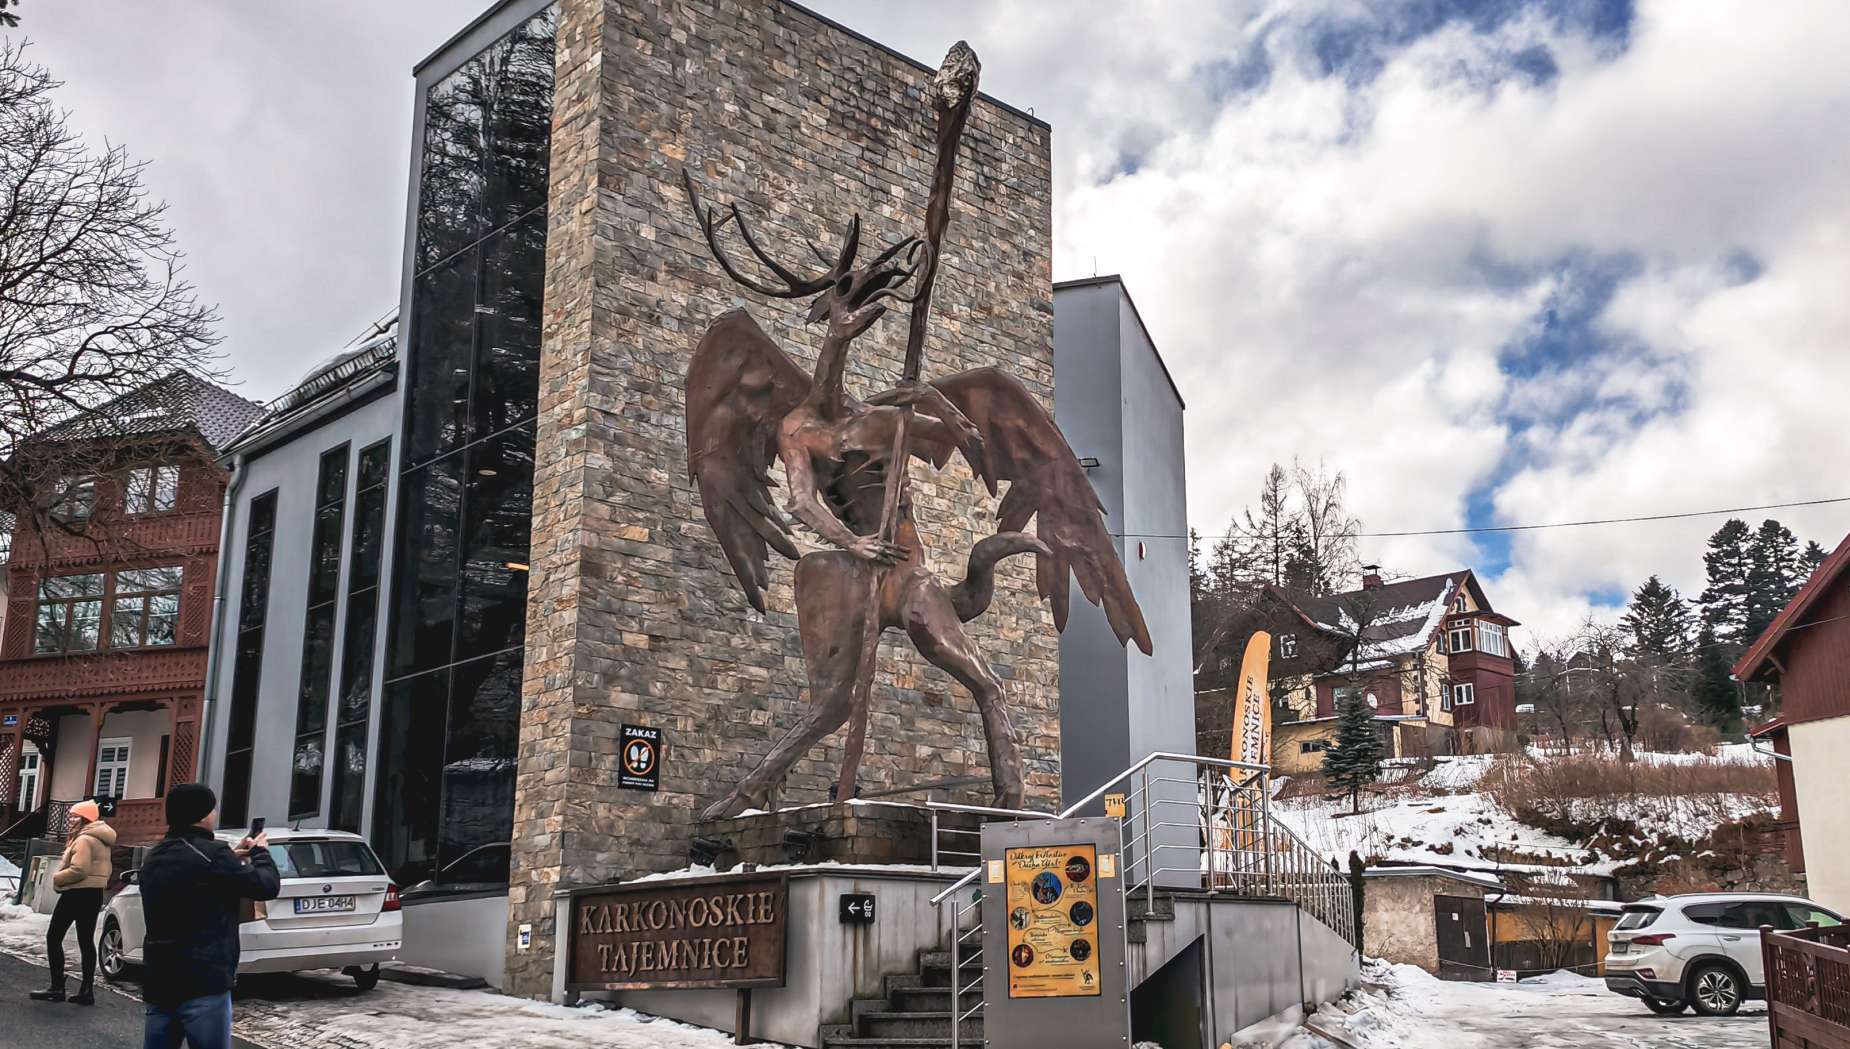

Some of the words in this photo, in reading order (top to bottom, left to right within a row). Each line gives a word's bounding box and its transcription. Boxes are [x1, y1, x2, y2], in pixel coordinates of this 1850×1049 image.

[625, 728, 657, 739] ZAKAZ
[1250, 694, 1260, 768] EMNICE
[302, 898, 326, 910] DJE
[580, 891, 775, 935] KARKONOSKIE
[597, 936, 748, 978] TAJEMNICE
